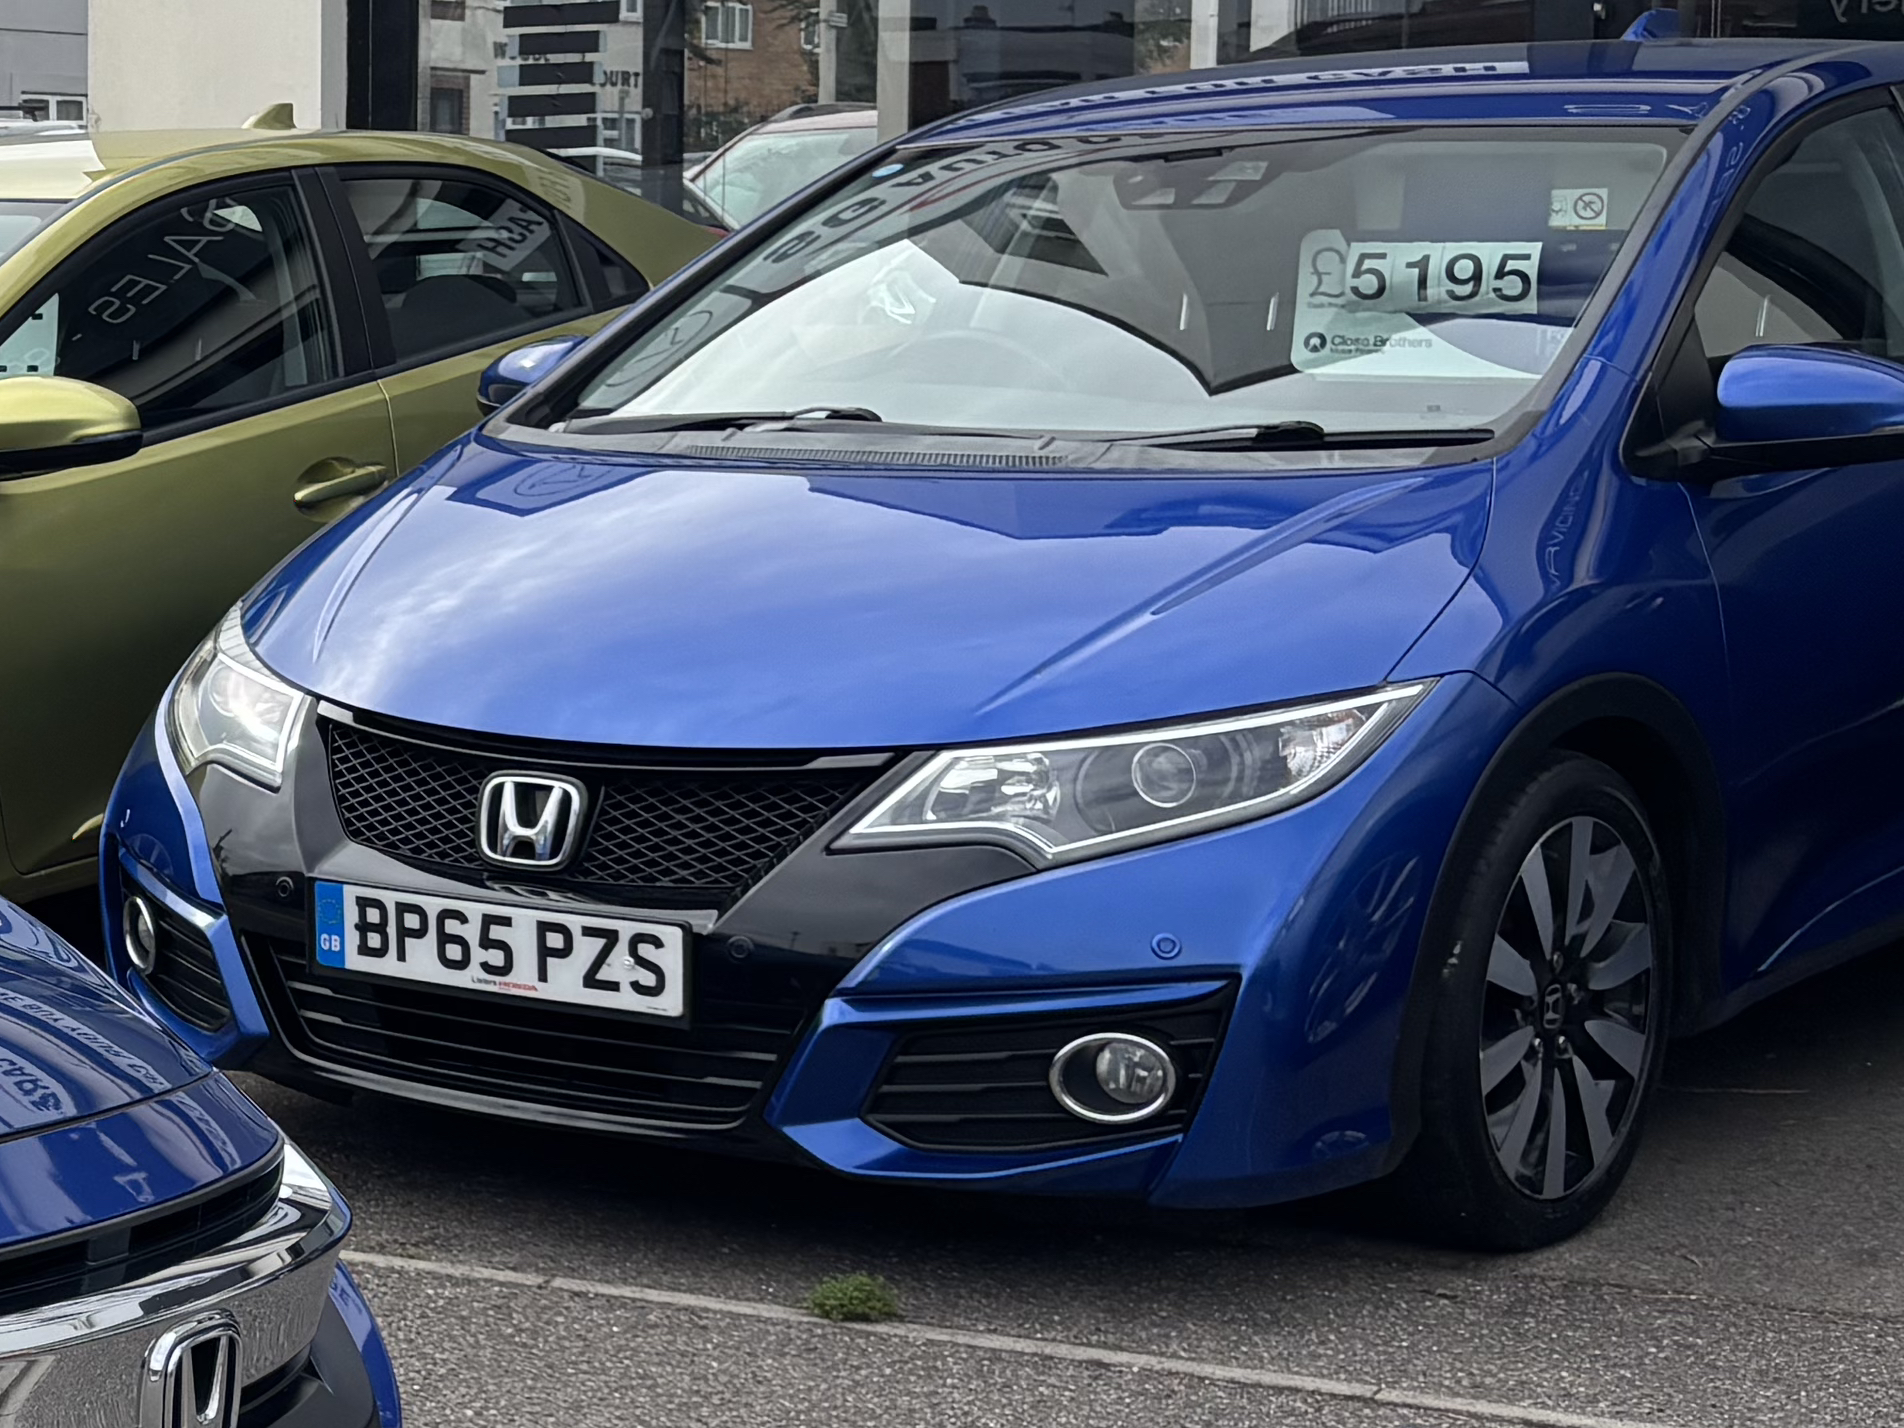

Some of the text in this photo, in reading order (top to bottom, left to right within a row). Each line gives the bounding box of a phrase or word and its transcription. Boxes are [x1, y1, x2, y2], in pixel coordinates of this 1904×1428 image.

[591, 70, 641, 88] OURT
[1309, 247, 1532, 303] £5195
[1373, 335, 1432, 348] Brothers
[320, 933, 340, 952] GB
[354, 895, 666, 998] BP65 PZS
